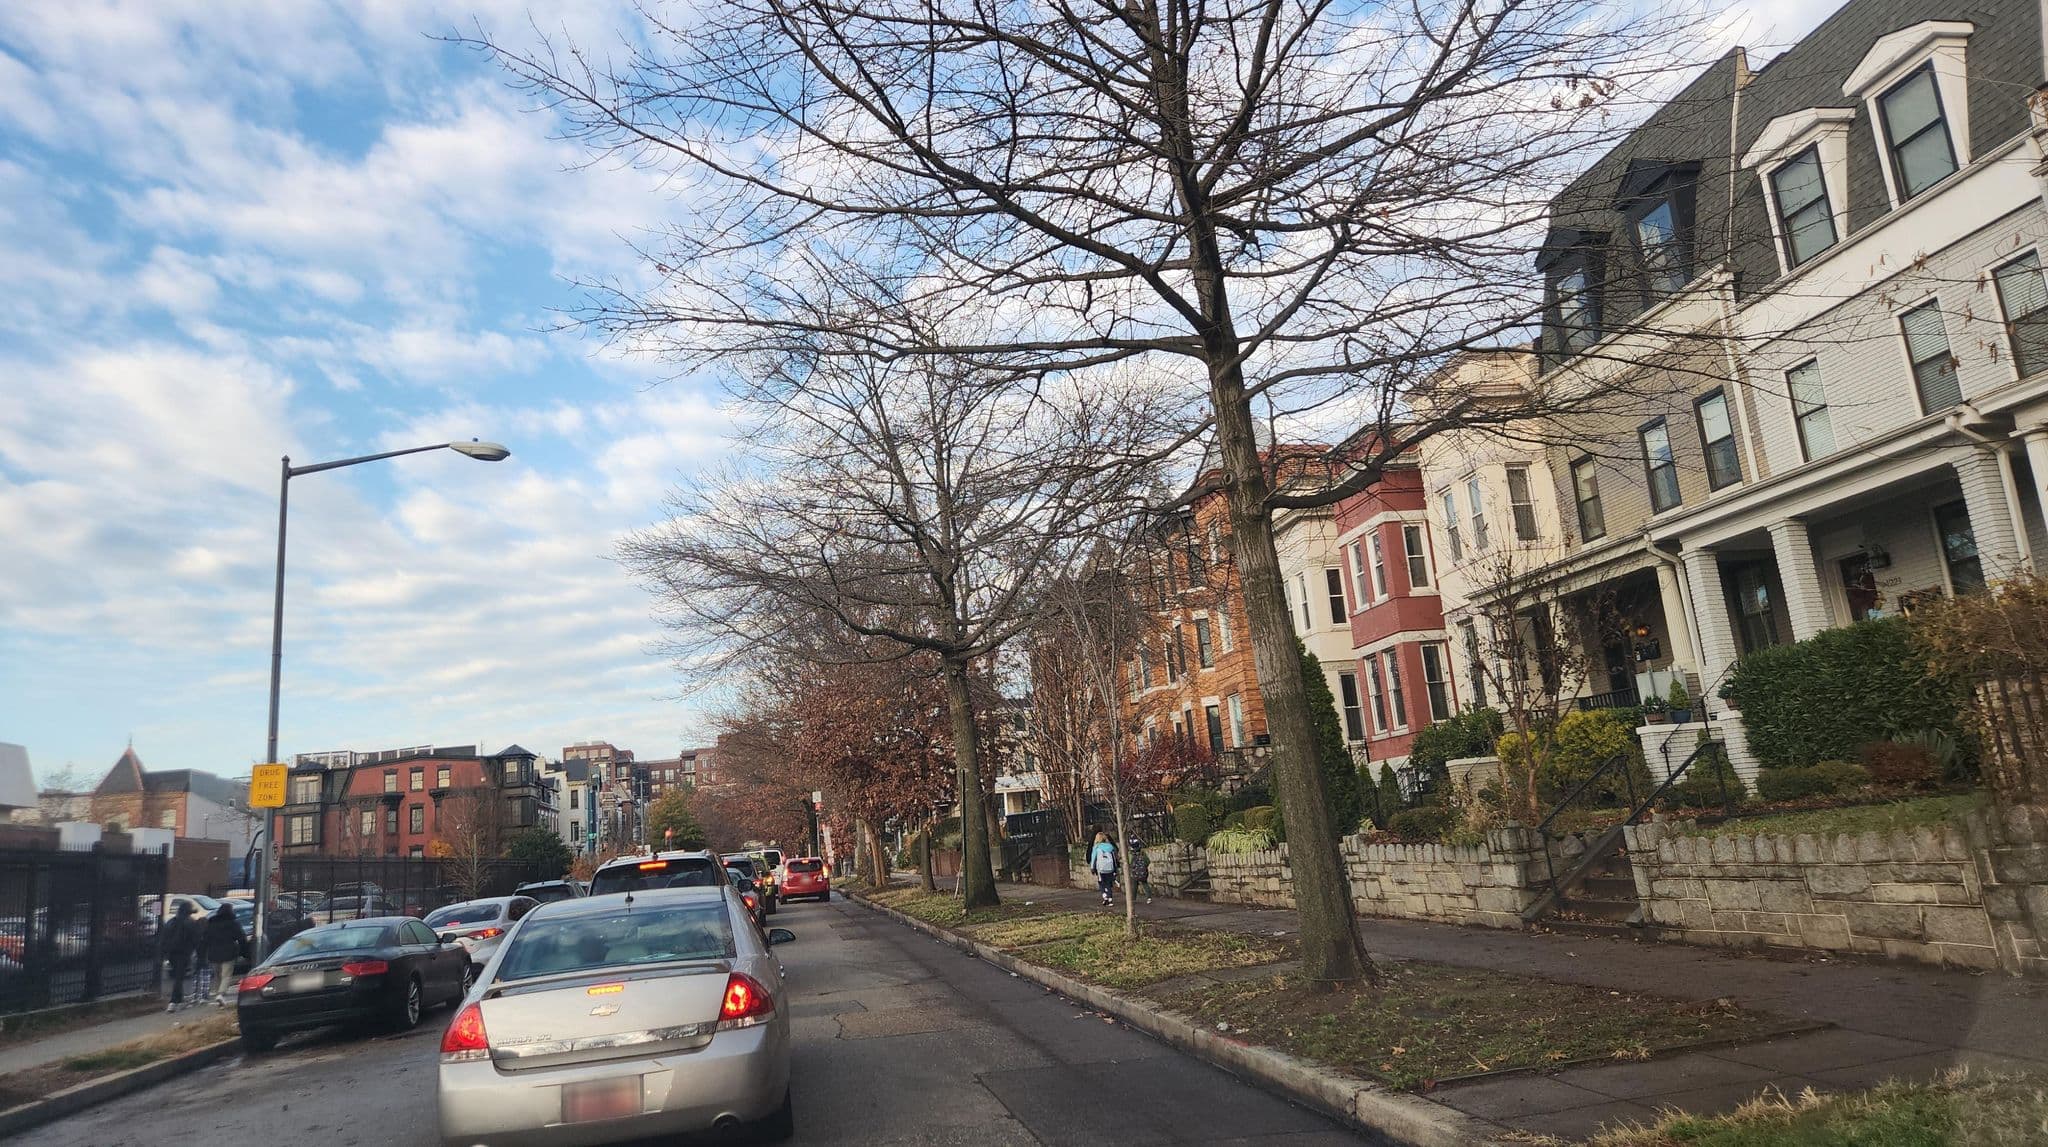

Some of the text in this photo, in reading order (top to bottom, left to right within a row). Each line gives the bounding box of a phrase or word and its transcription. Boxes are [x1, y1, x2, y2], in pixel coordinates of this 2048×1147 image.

[260, 768, 281, 777] DRUG
[258, 781, 280, 790] FREE
[258, 794, 280, 802] ZONE
